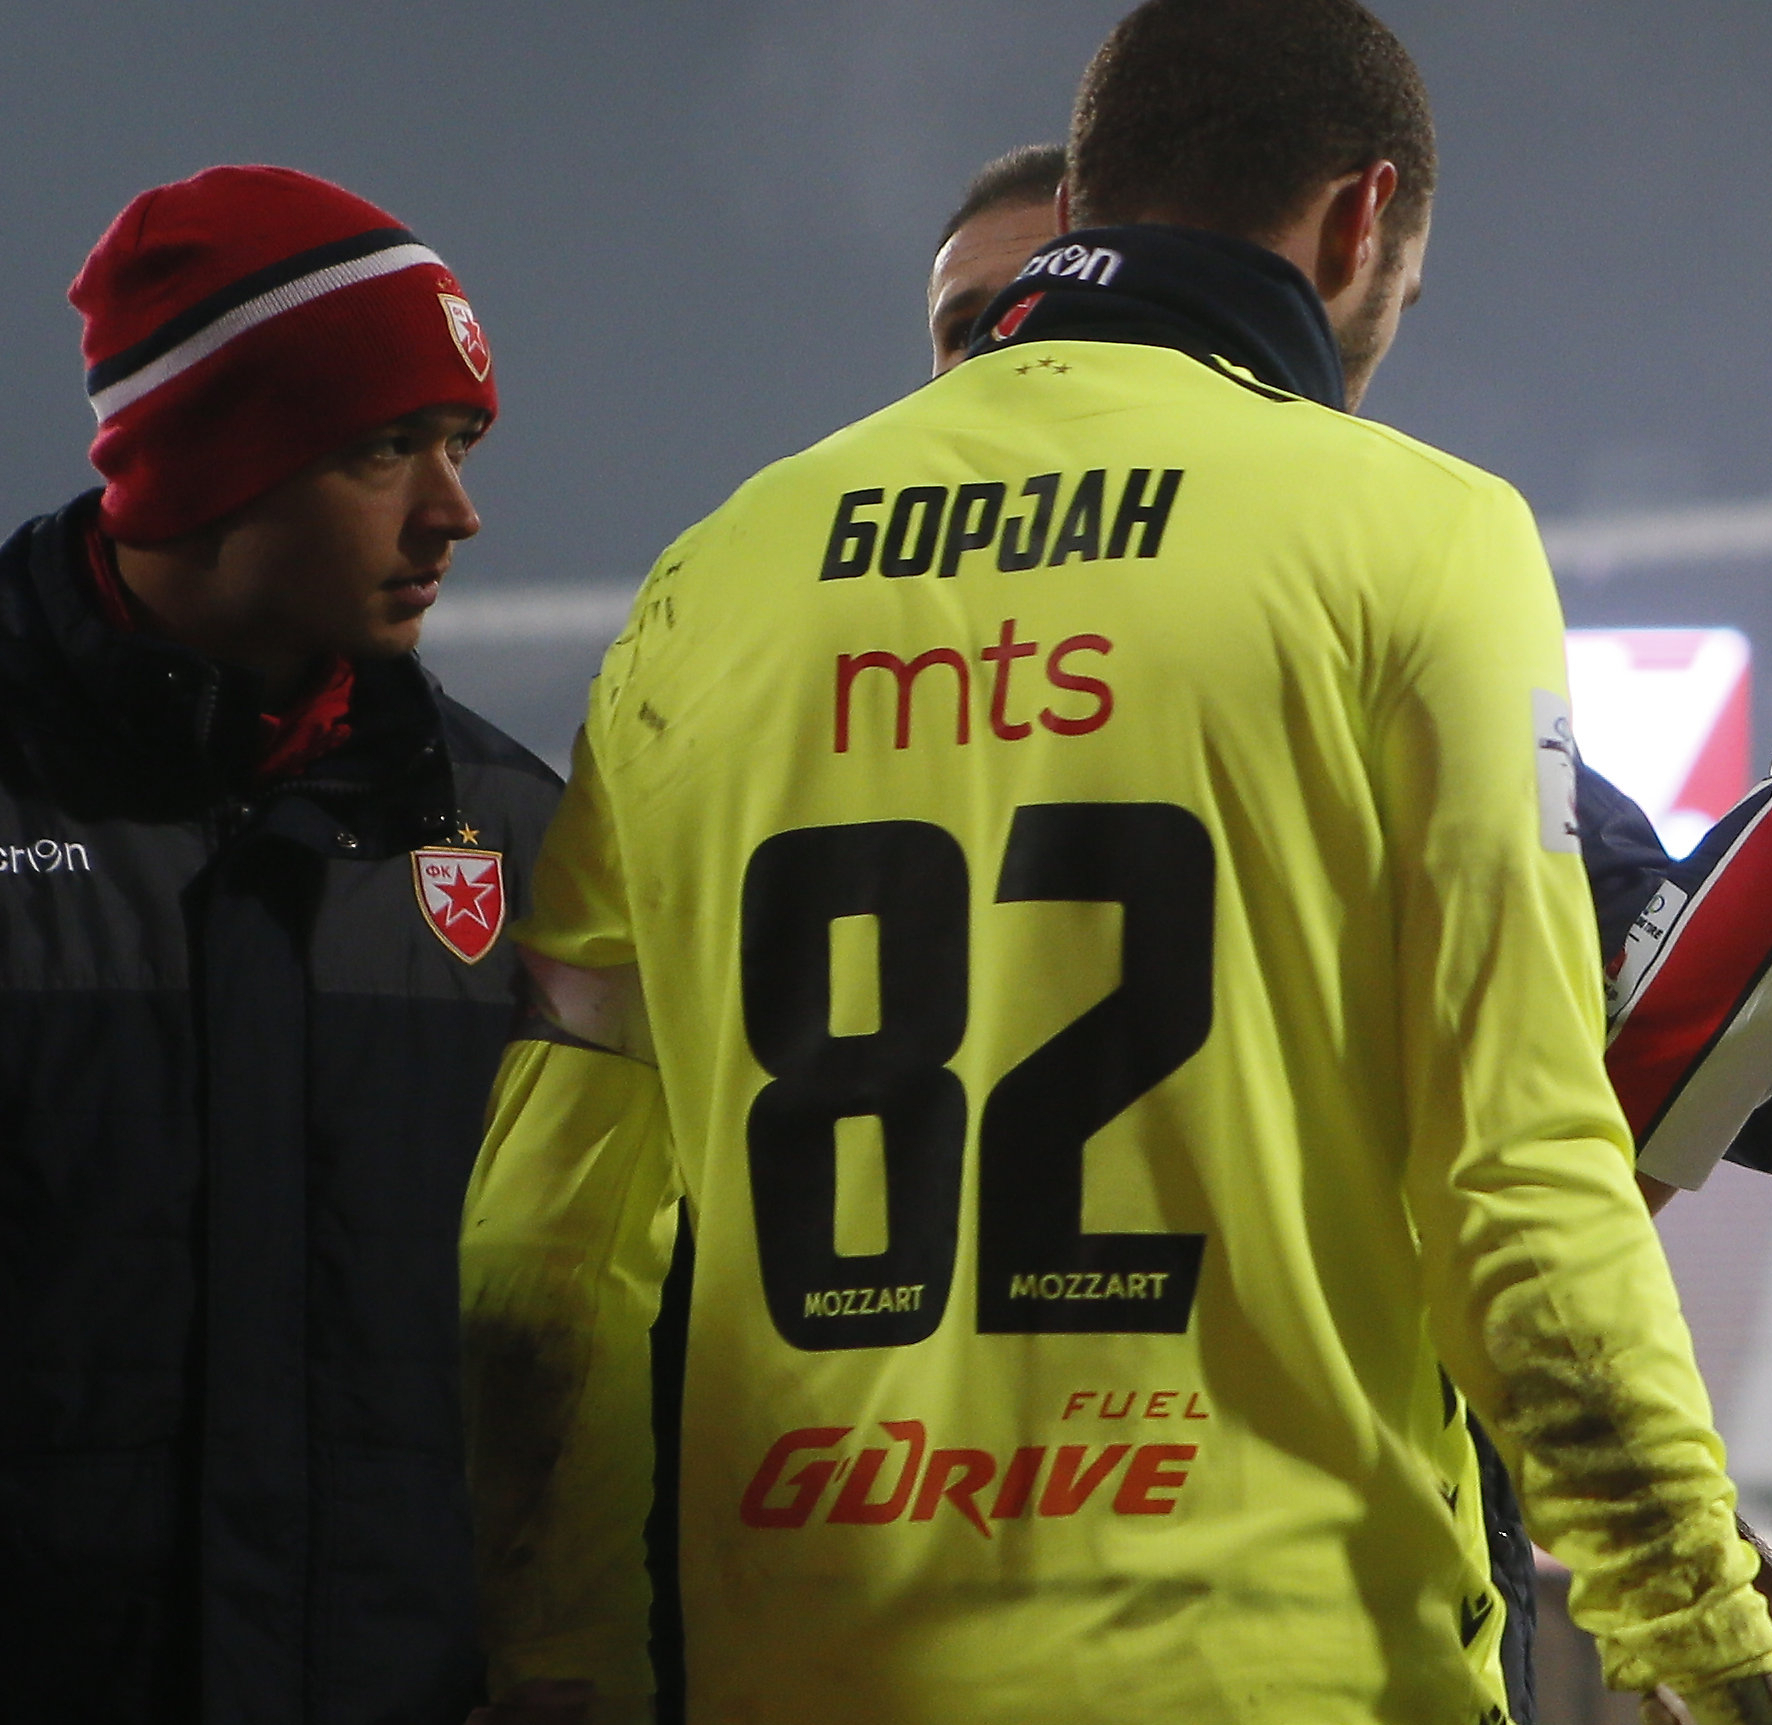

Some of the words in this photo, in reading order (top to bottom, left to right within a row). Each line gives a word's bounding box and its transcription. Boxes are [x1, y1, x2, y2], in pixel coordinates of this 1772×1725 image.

[834, 619, 1115, 753] mts
[739, 801, 1216, 1352] 82
[804, 1285, 926, 1319] MOZZART
[1010, 1272, 1170, 1301] MOZZART
[1062, 1390, 1210, 1421] FUEL
